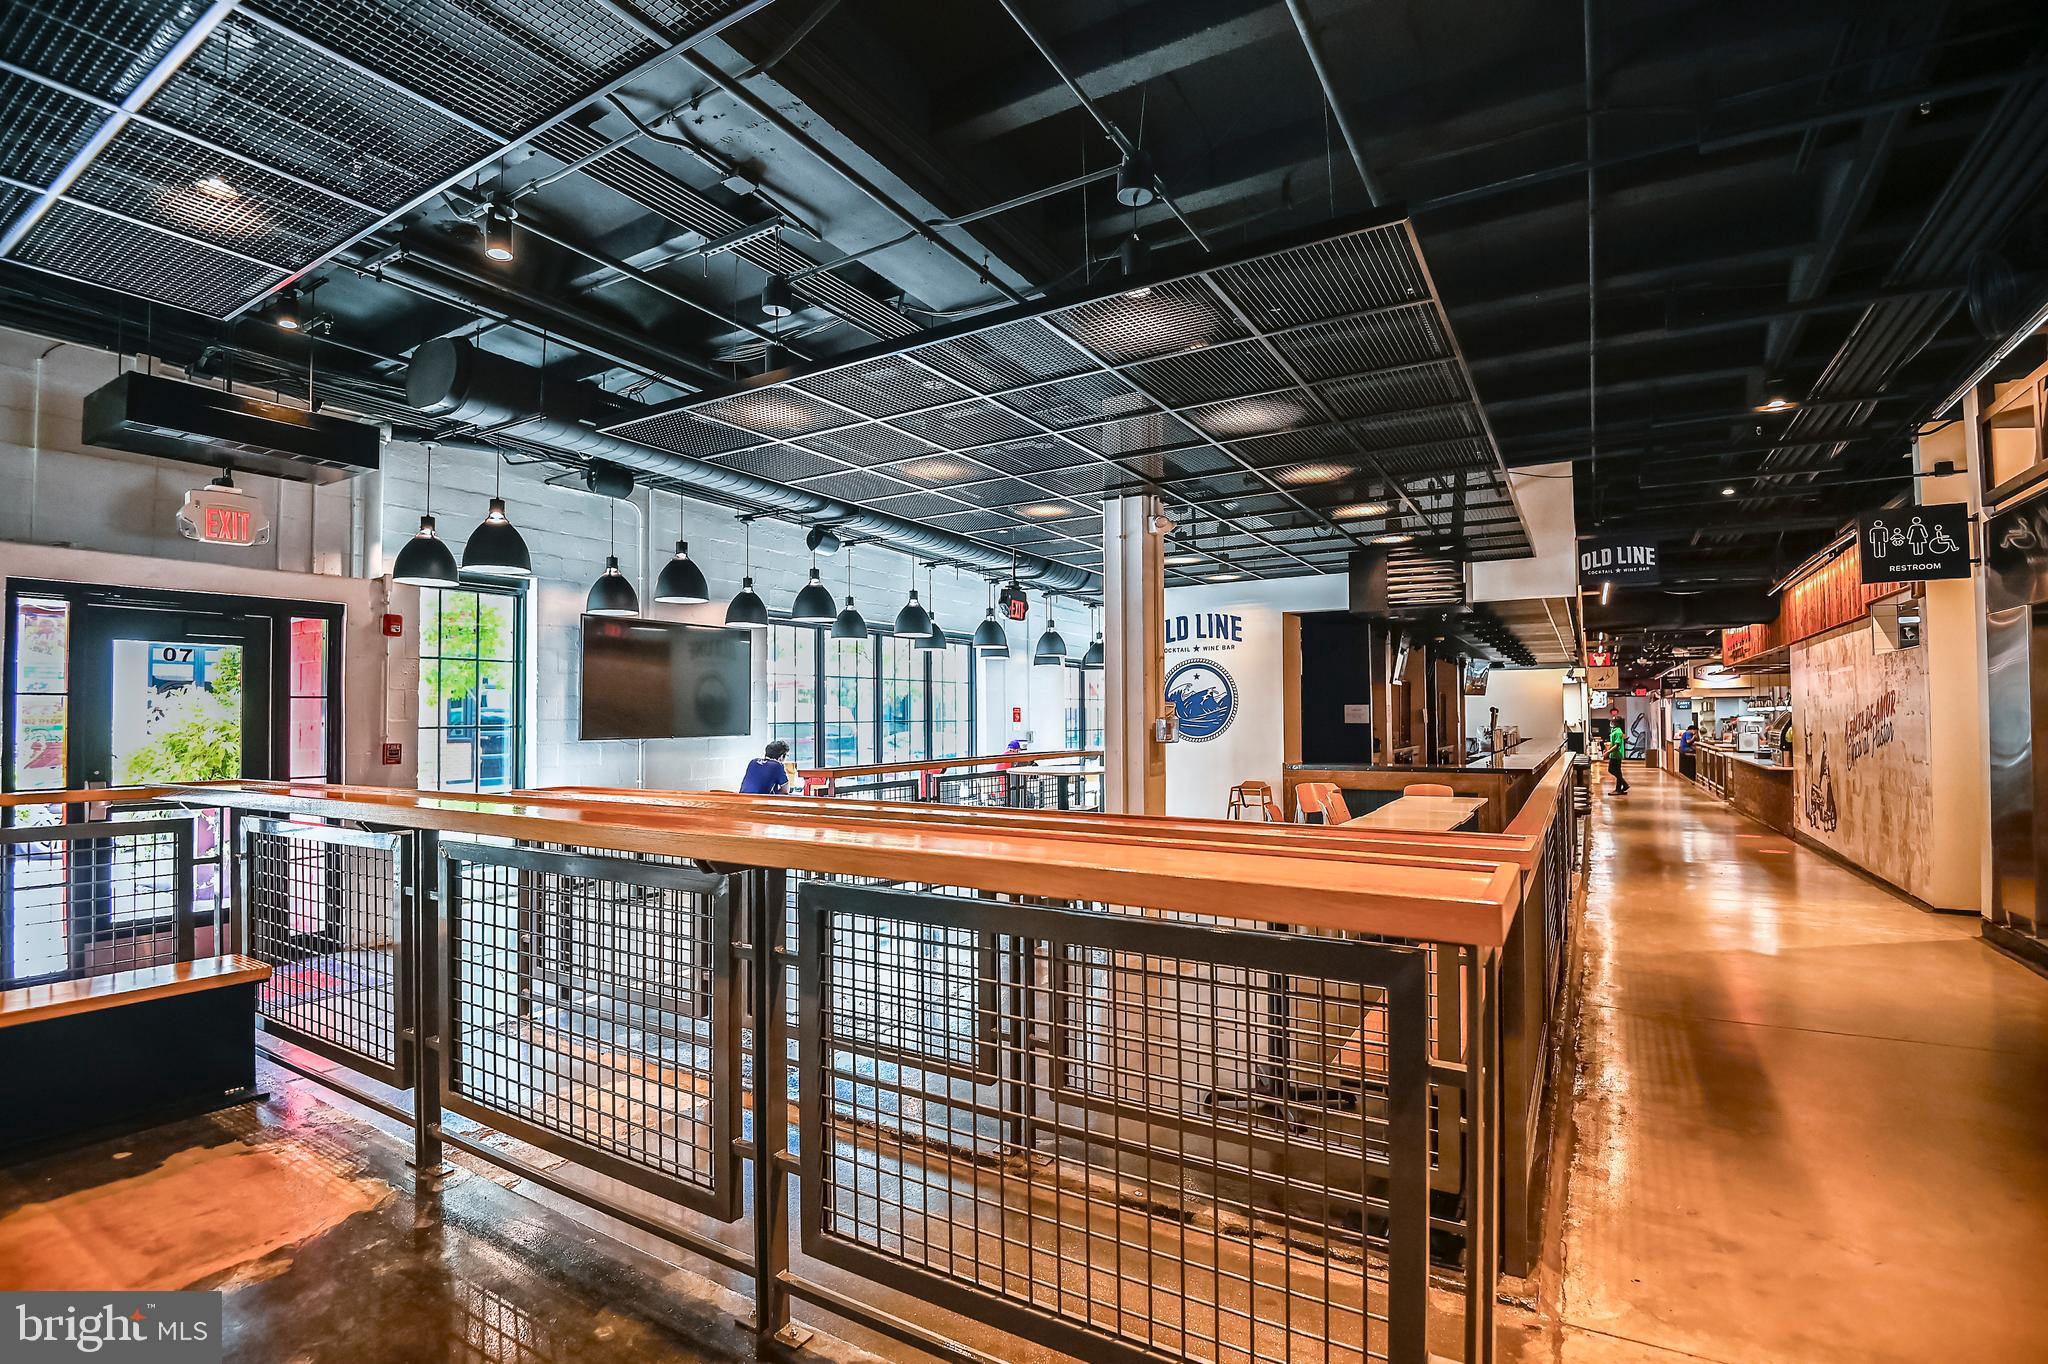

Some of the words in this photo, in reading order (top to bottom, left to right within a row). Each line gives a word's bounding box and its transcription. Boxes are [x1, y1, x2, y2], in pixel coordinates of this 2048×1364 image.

[205, 508, 250, 541] EXIT
[1581, 548, 1612, 571] OLD
[1617, 546, 1655, 565] LINE
[1889, 562, 1941, 572] RESTROOM
[1011, 600, 1024, 619] EXIT
[1165, 615, 1189, 643] LD
[1195, 613, 1242, 642] LINE
[162, 647, 193, 663] 07
